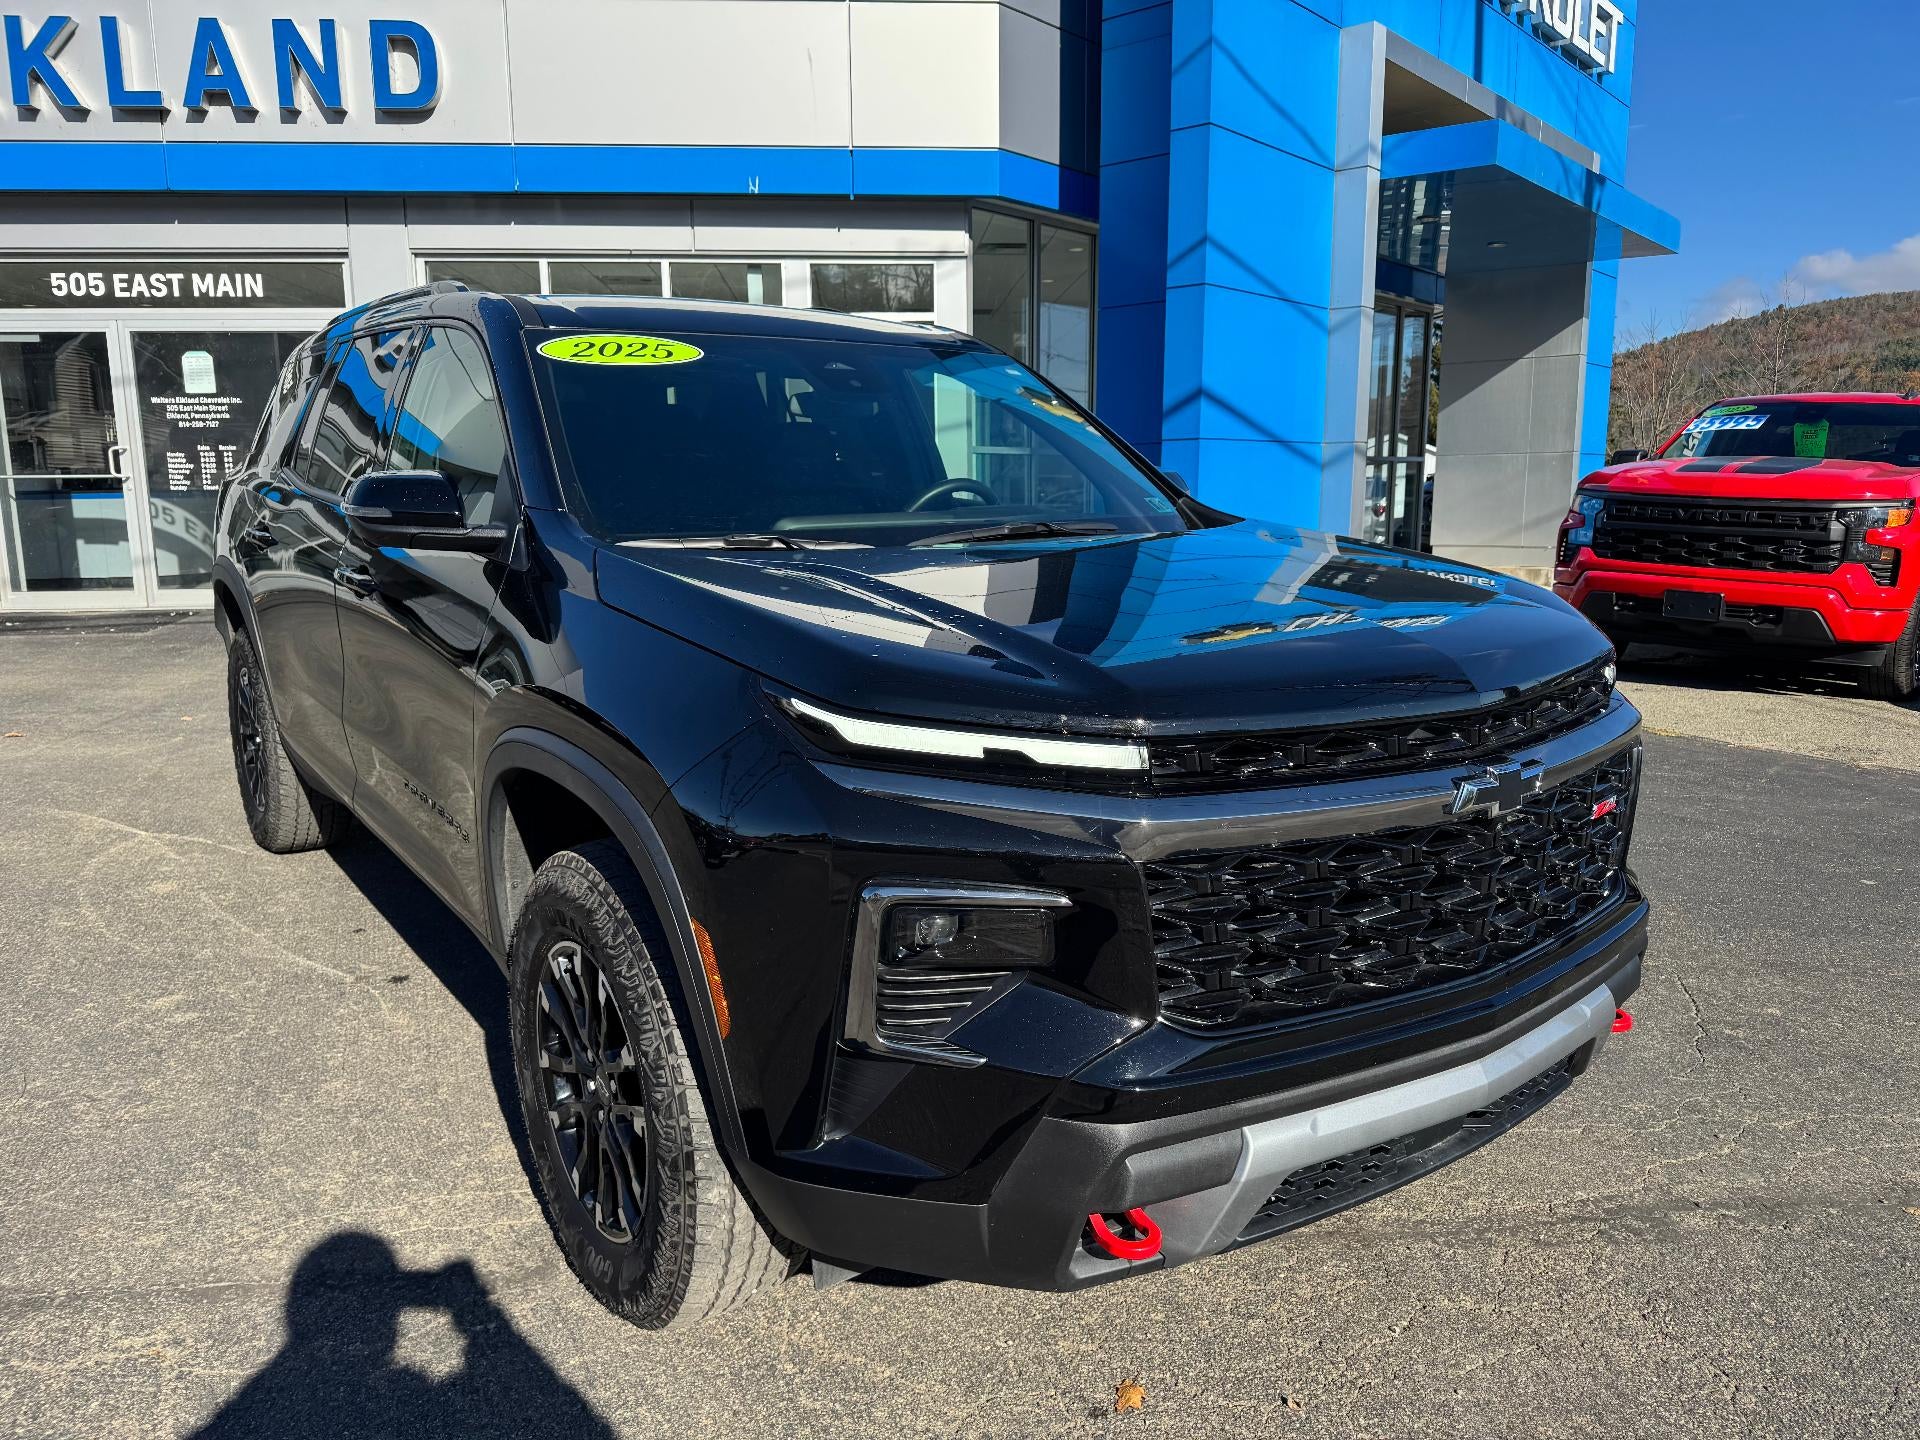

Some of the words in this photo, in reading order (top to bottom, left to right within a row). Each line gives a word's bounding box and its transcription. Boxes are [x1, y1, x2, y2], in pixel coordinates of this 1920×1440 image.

[50, 272, 106, 297] 505
[112, 273, 184, 298] EAST
[191, 273, 264, 298] MAIN
[569, 341, 675, 360] 2025
[190, 412, 231, 421] Pennsylvania
[167, 462, 195, 470] Wednesday
[168, 473, 184, 481] Friday
[1613, 504, 1831, 530] CHEVROLET
